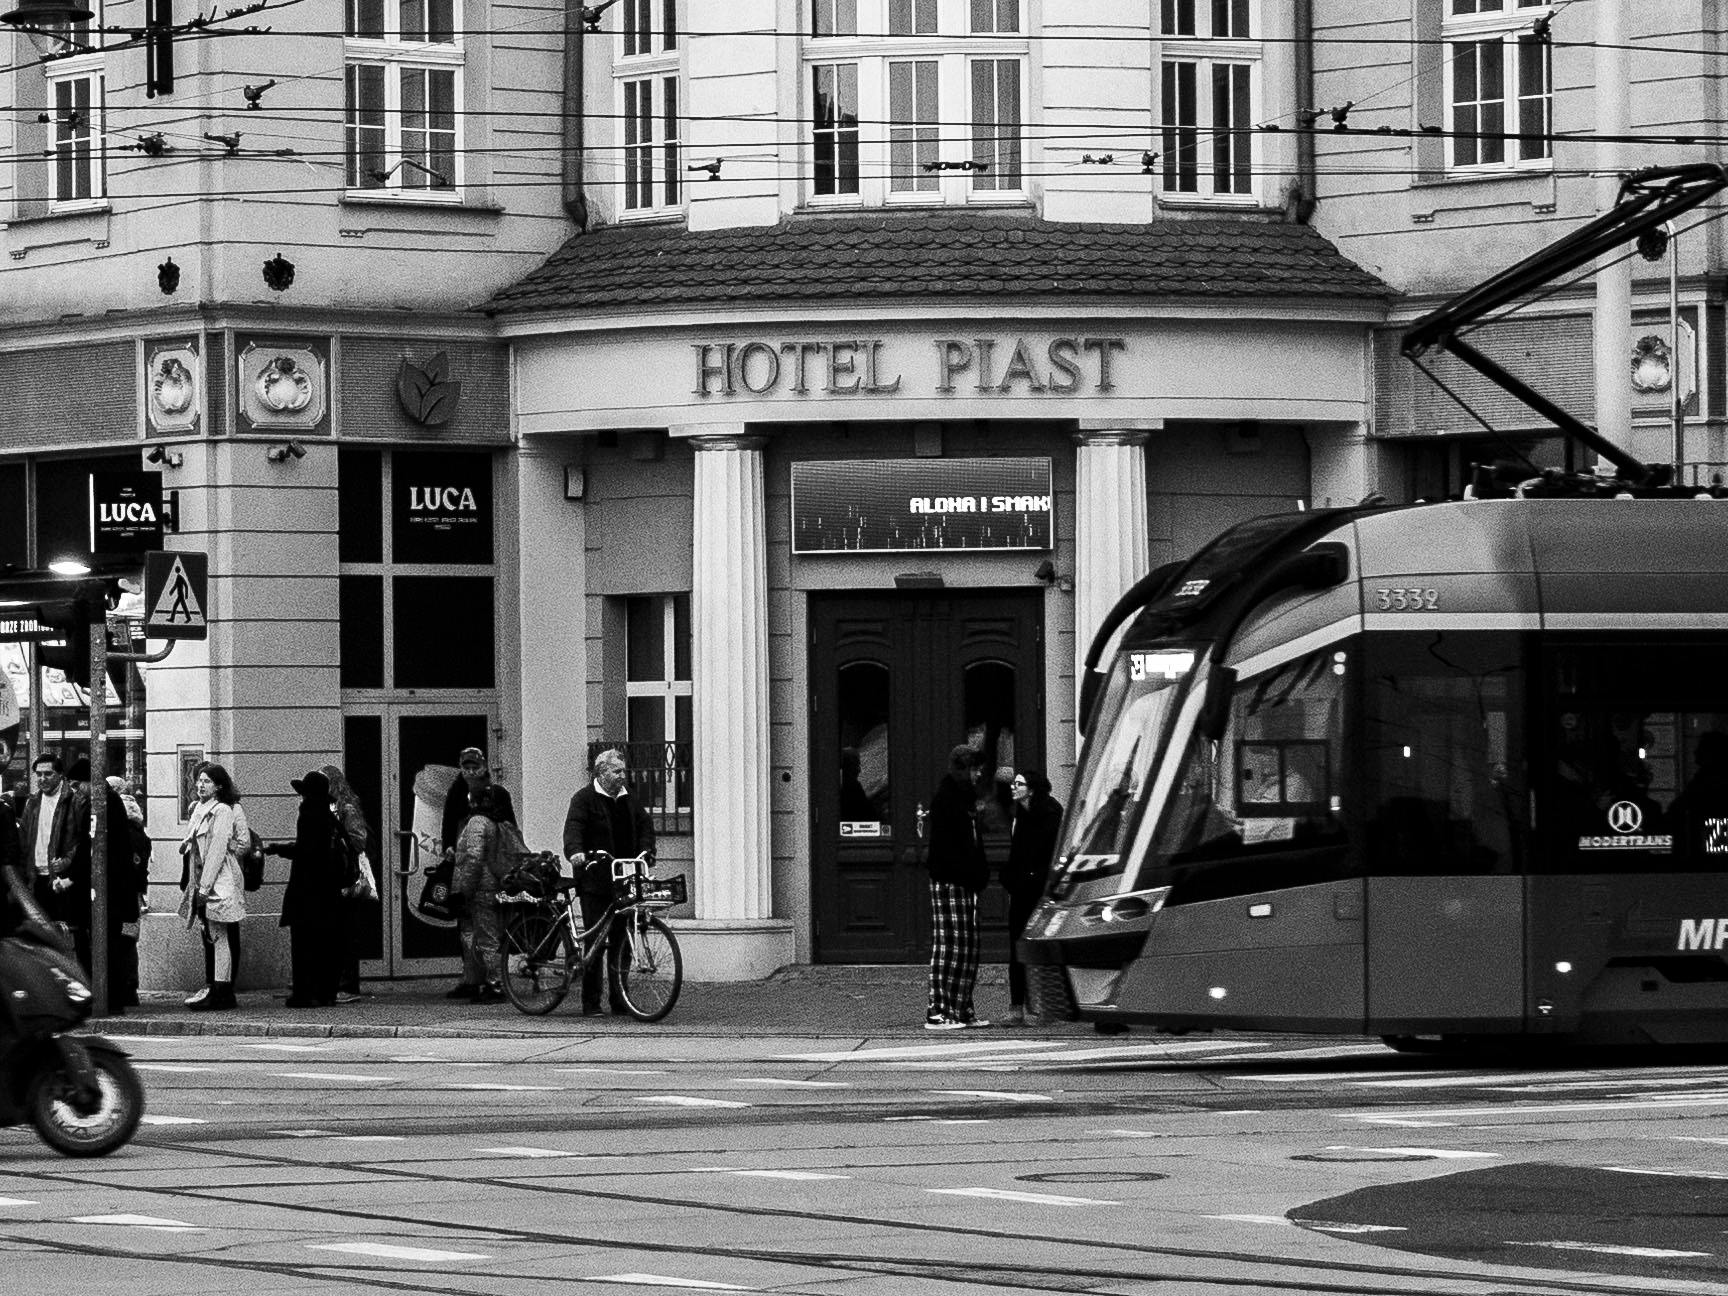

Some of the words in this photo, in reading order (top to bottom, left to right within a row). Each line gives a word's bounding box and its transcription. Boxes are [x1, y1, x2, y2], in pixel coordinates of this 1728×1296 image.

[690, 339, 902, 394] HOTEL
[934, 337, 1127, 392] PIAST
[410, 487, 477, 510] LUCA
[910, 497, 977, 513] ALOHA
[100, 503, 157, 522] LUCA
[1377, 588, 1439, 611] 3332
[1578, 834, 1673, 848] MODERTRANS
